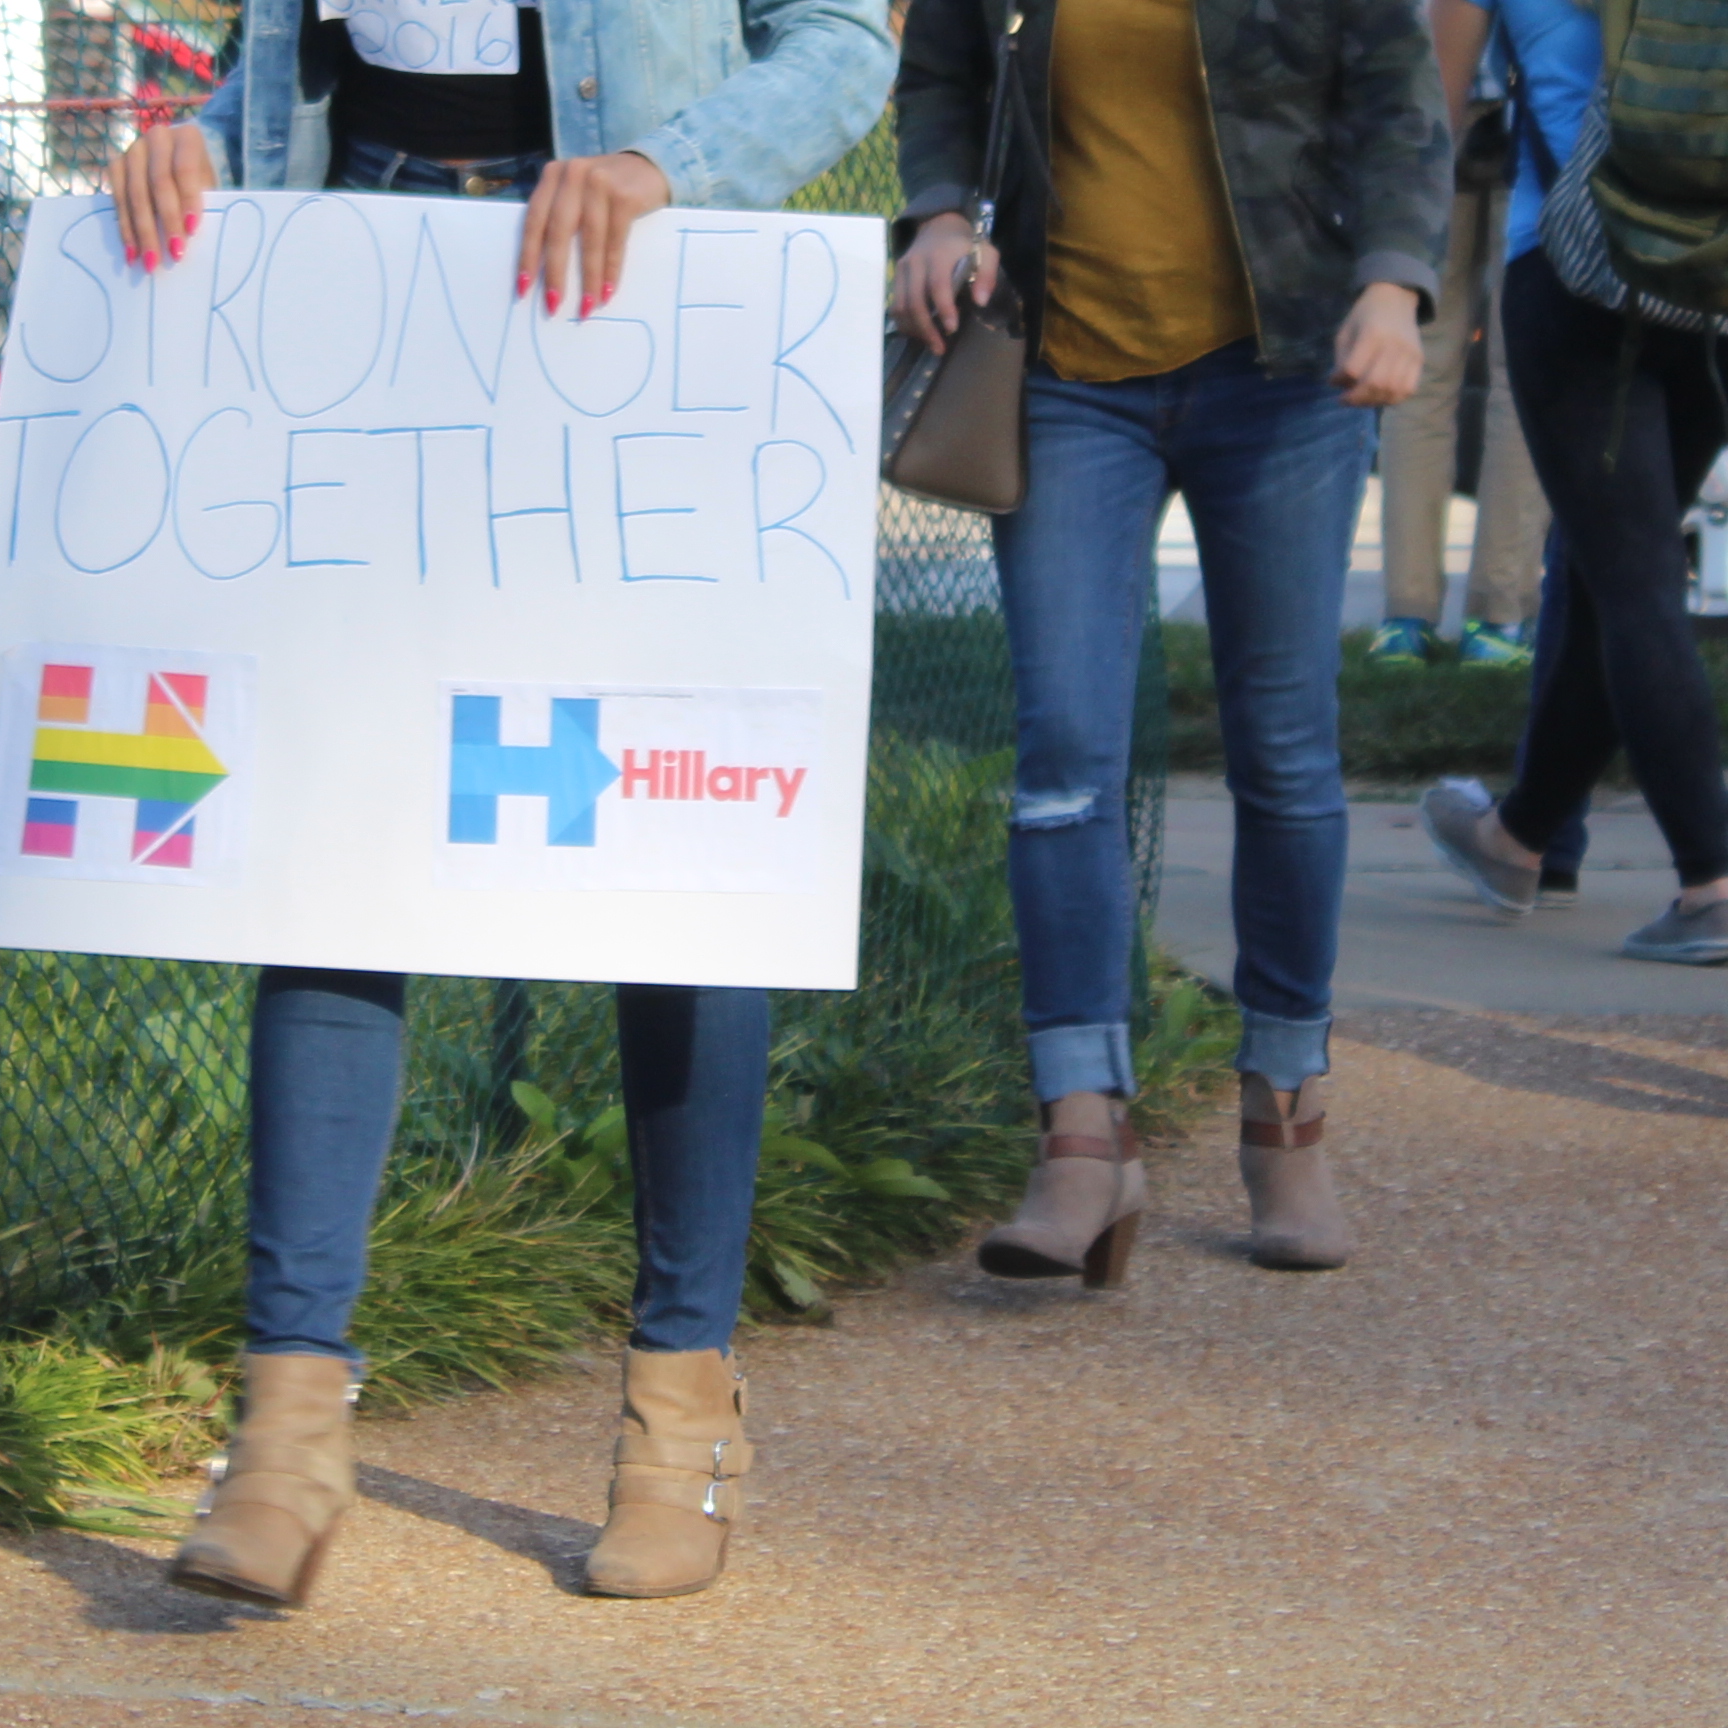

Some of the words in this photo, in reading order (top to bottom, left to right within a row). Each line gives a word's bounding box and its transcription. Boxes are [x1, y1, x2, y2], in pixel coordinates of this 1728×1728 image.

[350, 10, 513, 68] 2016
[21, 194, 855, 453] STRONGER
[621, 748, 809, 819] Hillary
